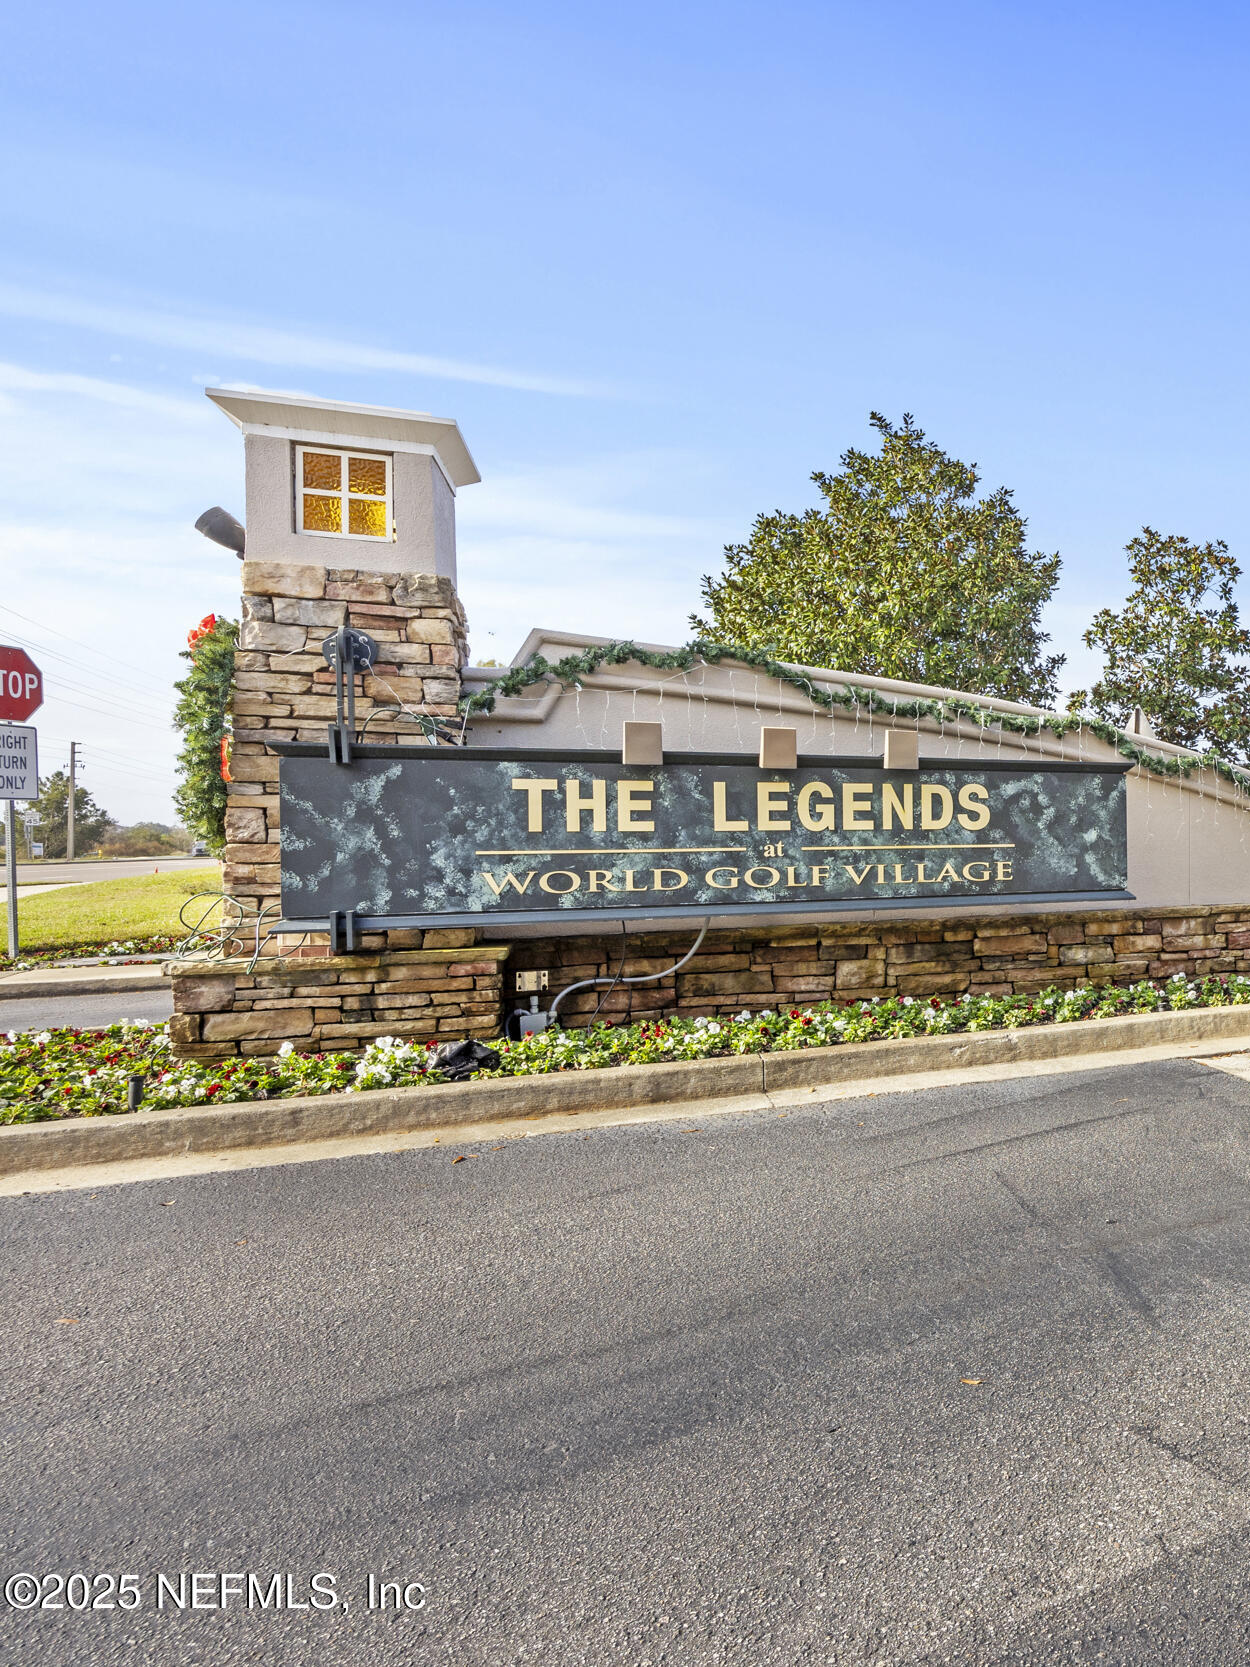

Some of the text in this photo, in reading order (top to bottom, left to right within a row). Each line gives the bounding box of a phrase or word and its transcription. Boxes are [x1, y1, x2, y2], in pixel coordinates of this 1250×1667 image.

[0, 669, 38, 699] TOP
[0, 734, 27, 750] IGHT
[511, 778, 991, 833] THE LEGENDS
[763, 840, 784, 858] at
[478, 861, 1014, 896] WORLD GOLF VILLAGE
